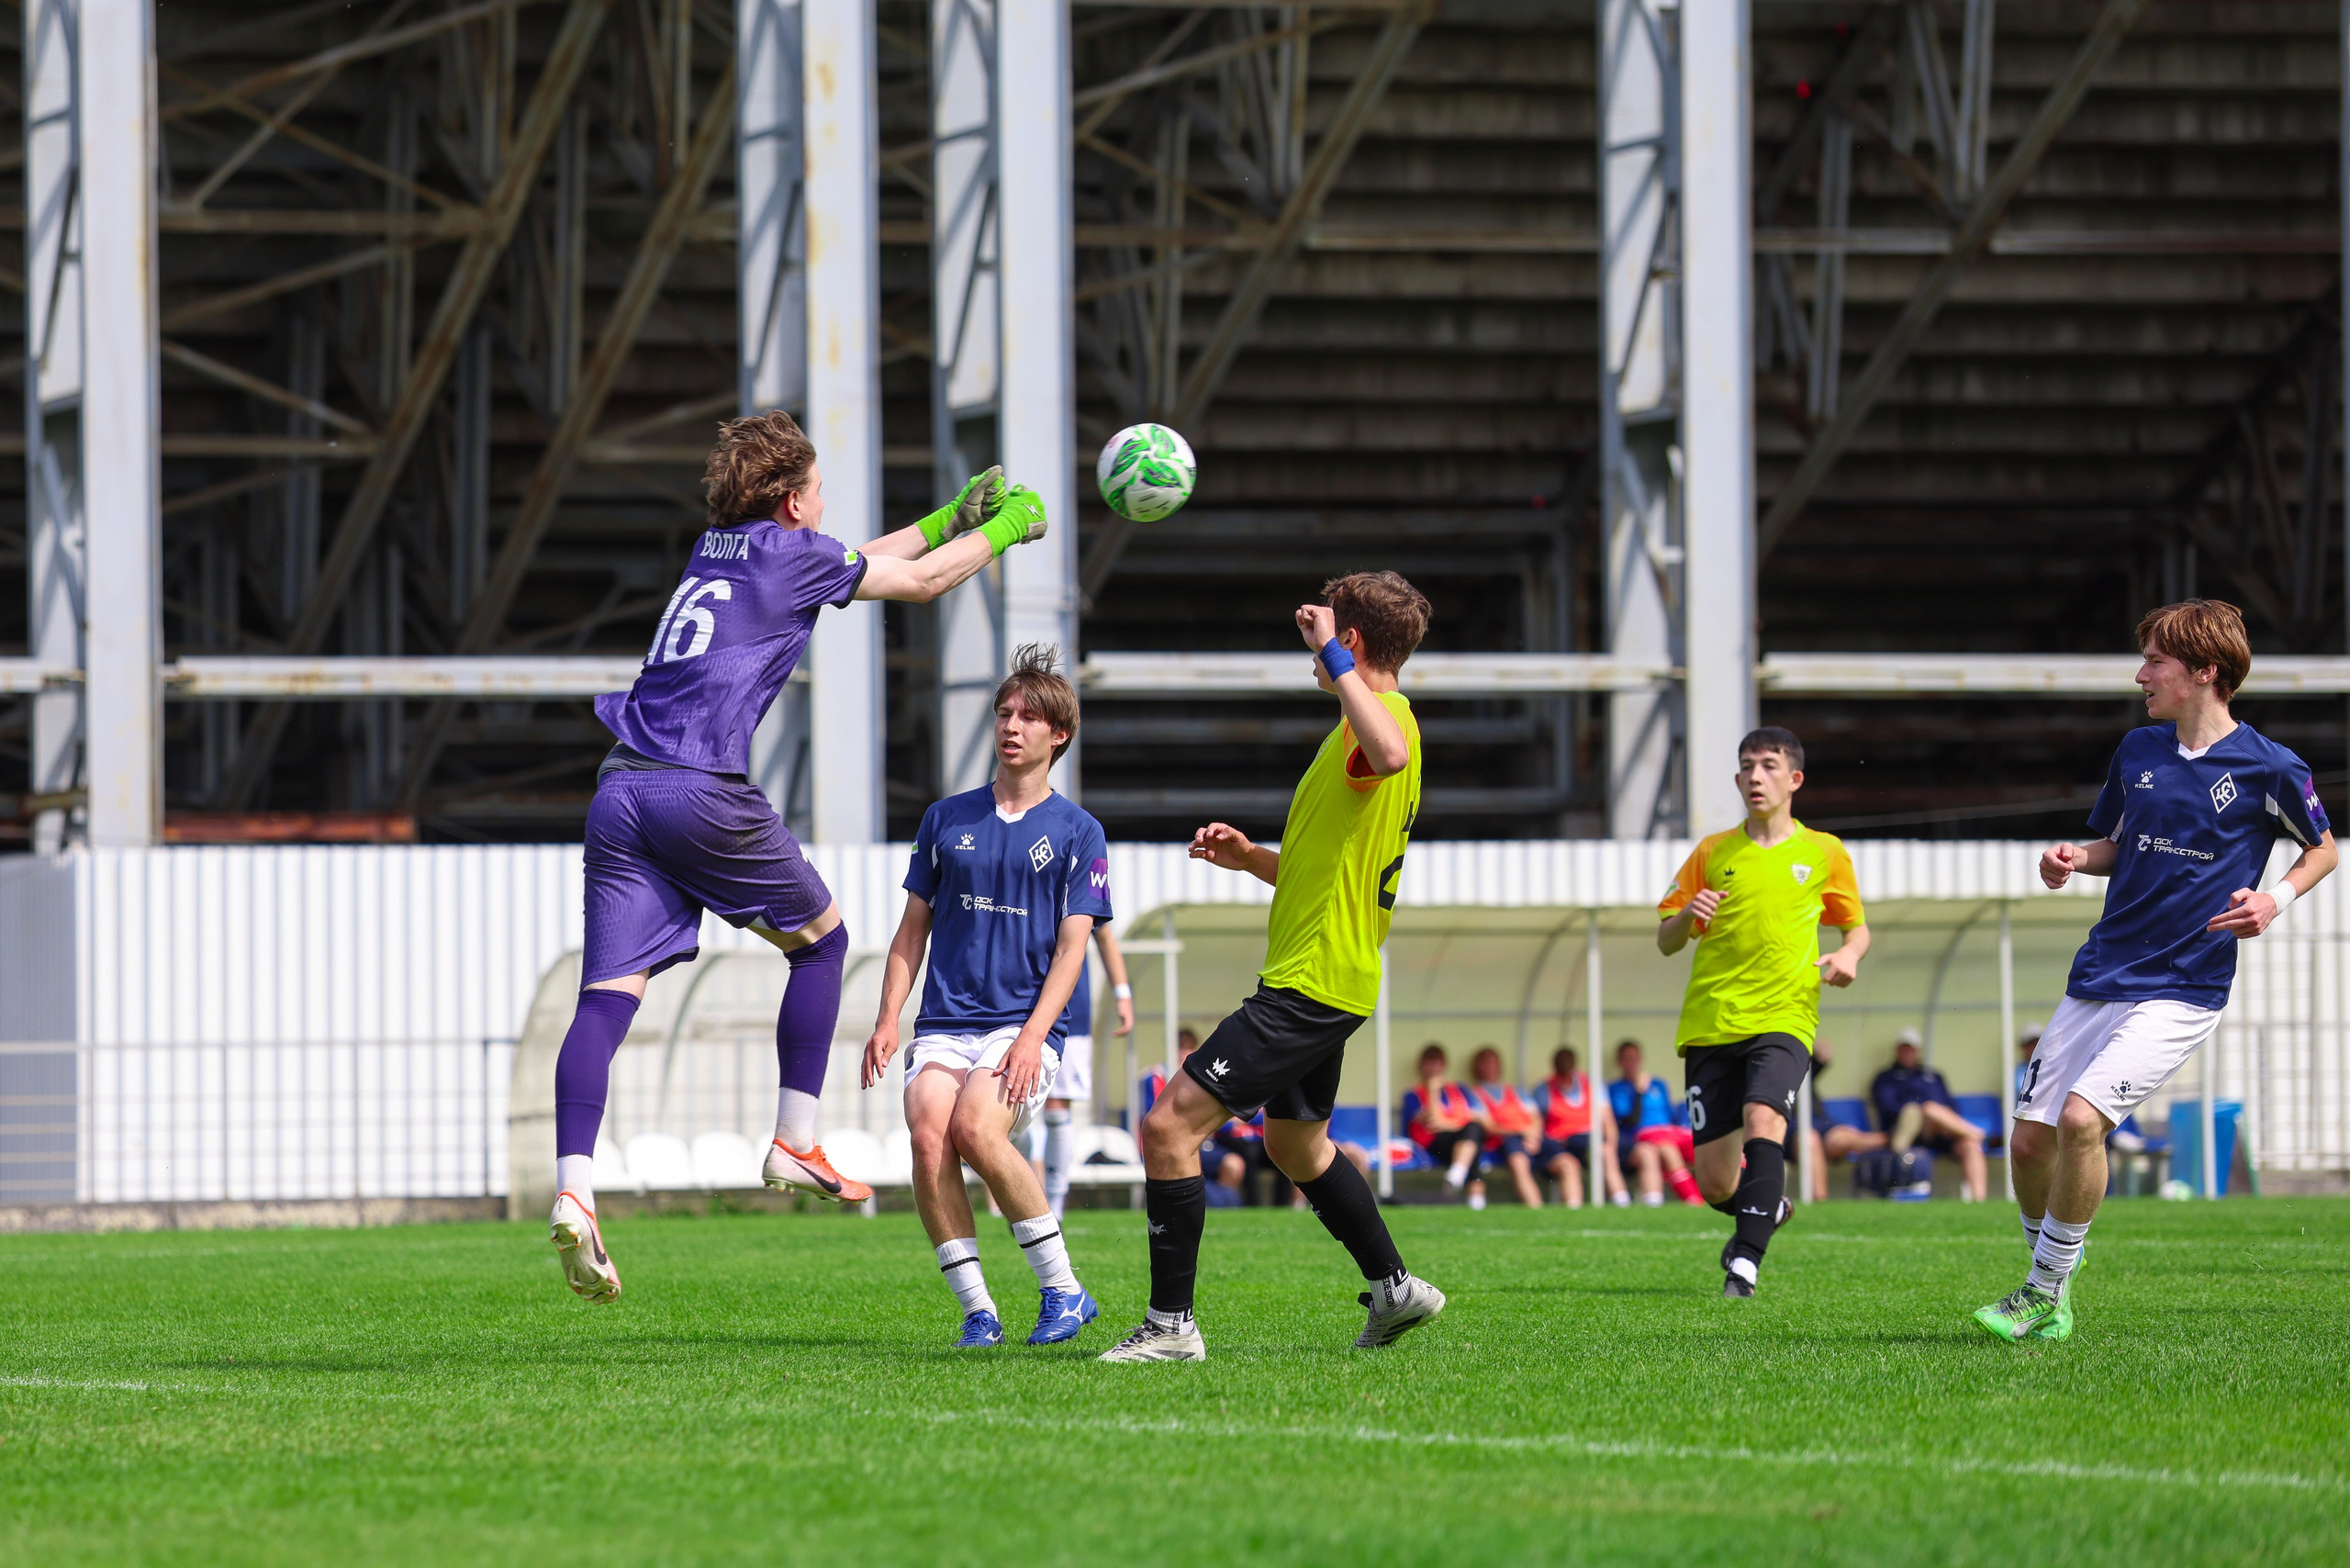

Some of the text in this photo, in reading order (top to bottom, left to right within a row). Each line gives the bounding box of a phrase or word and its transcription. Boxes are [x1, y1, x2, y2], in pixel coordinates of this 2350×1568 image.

[699, 531, 751, 560] ВОЛГА
[646, 577, 733, 666] 16
[2153, 845, 2215, 861] ТРАНССТРОЙ
[973, 902, 1028, 917] ТРАНССТРОЙ
[2110, 1085, 2126, 1102] KELME
